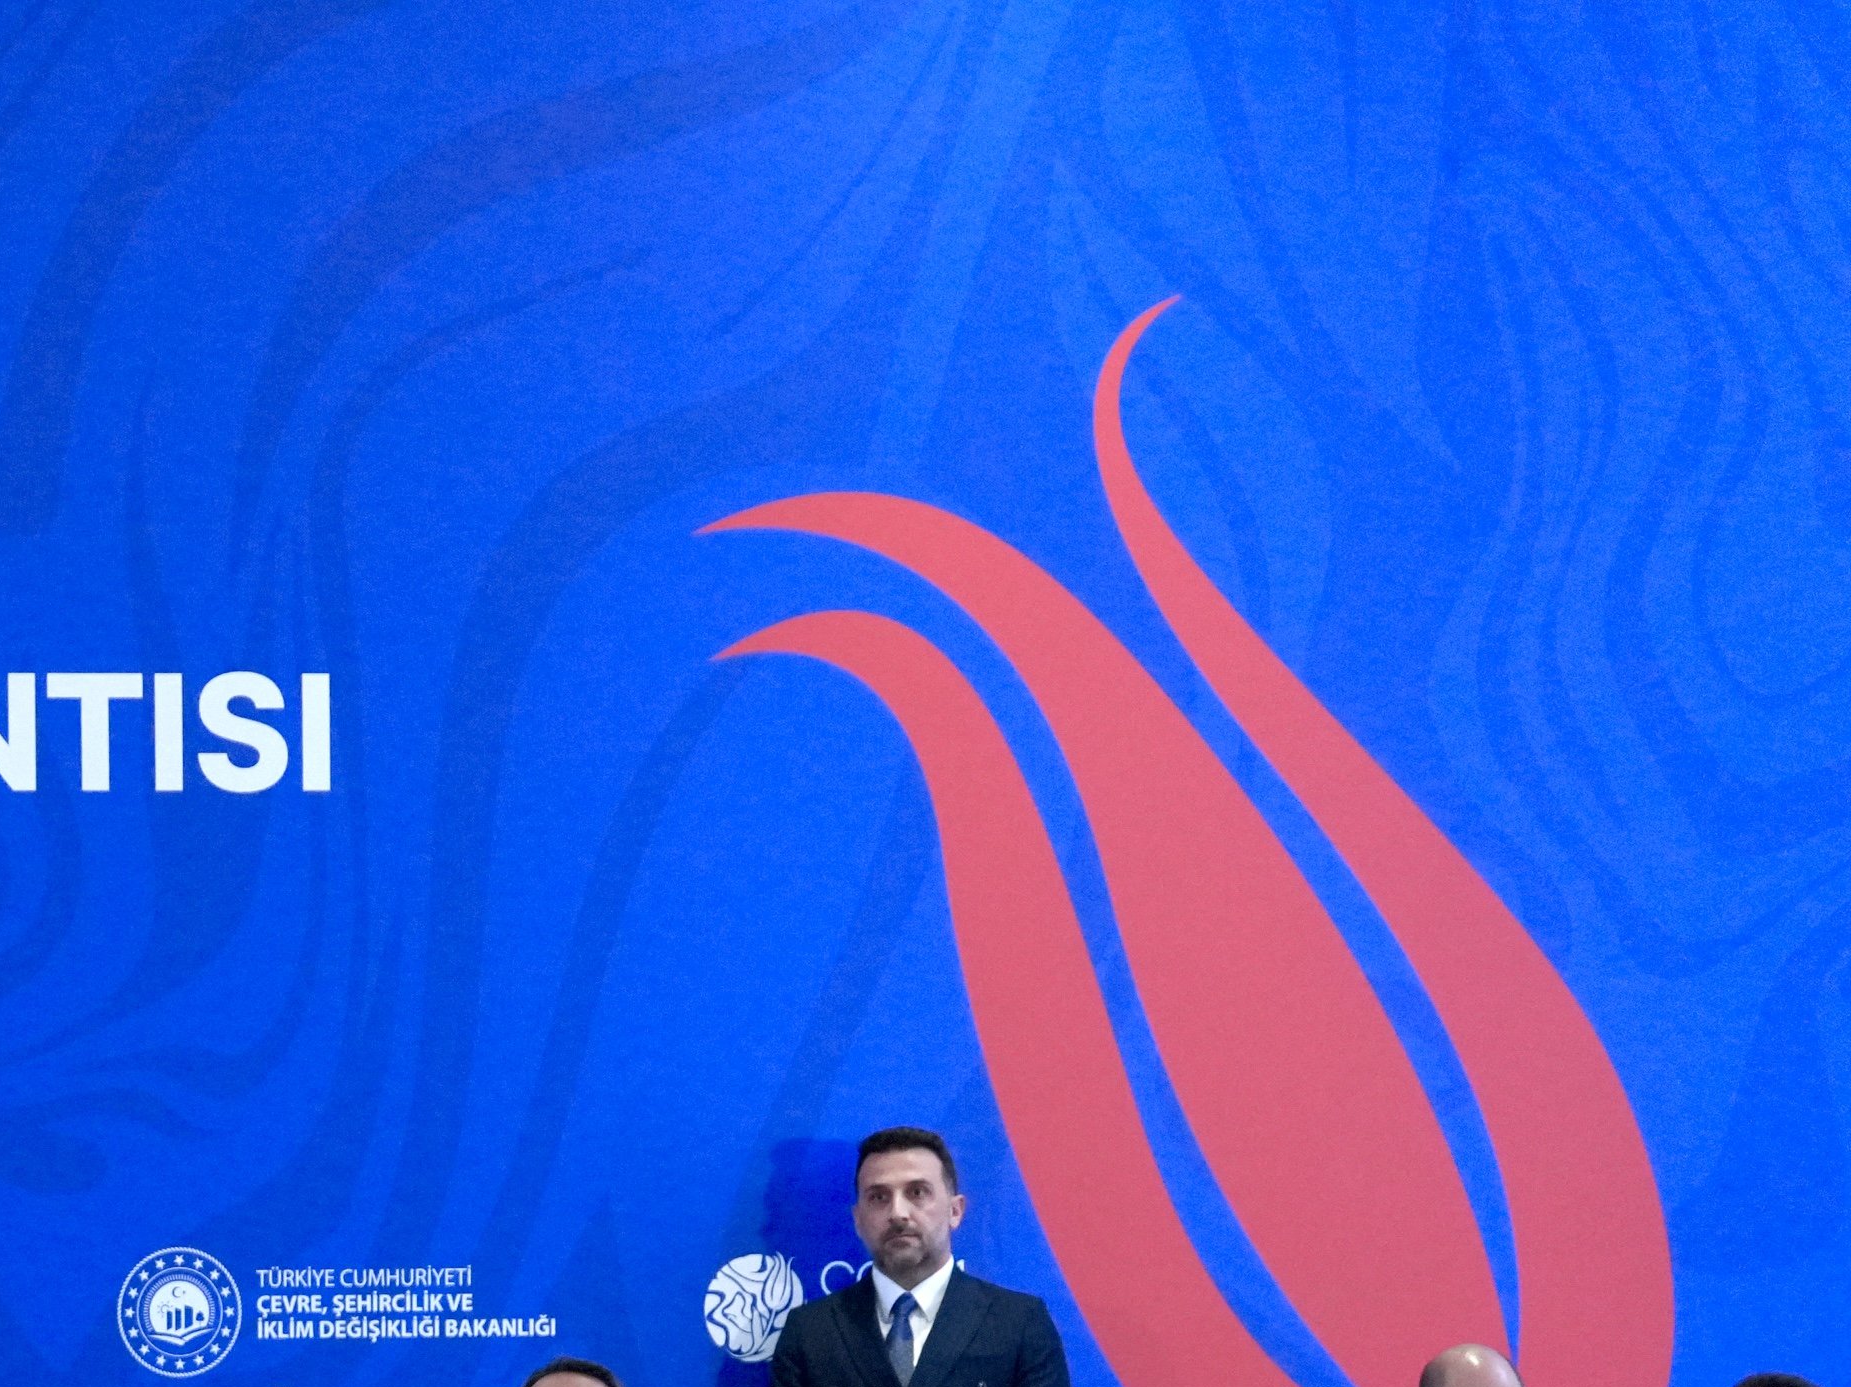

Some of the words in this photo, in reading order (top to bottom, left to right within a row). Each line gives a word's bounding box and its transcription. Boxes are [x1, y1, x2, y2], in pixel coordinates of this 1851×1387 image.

[255, 1266, 335, 1289] TÜRKİYE
[339, 1264, 472, 1288] CUMHURİYETİ
[256, 1294, 328, 1320] ÇEVRE,
[332, 1290, 444, 1319] ŞEHİRCİLİK
[446, 1293, 474, 1312] VE
[257, 1315, 314, 1339] İKLİM
[320, 1313, 440, 1343] DEĞİŞİKLİĞİ
[444, 1314, 556, 1338] BAKANLIĞI
